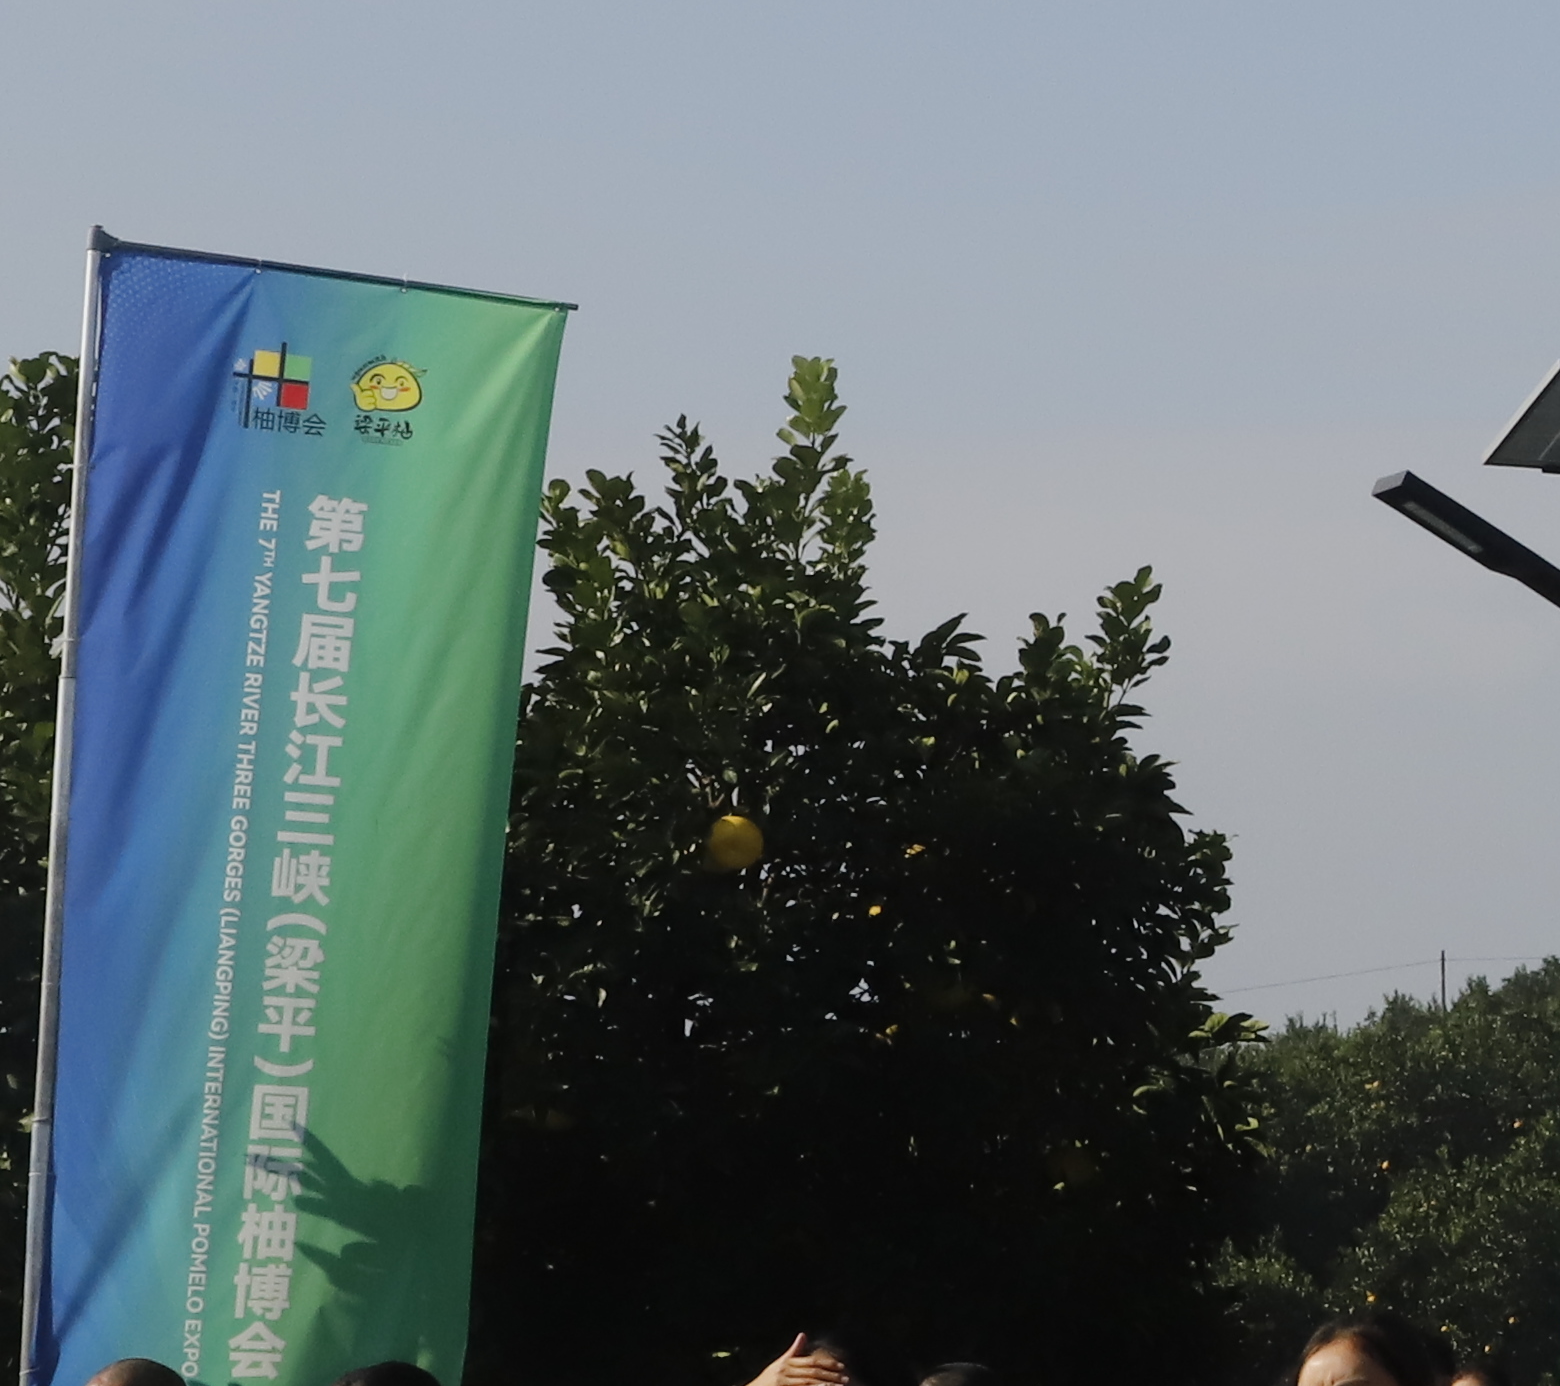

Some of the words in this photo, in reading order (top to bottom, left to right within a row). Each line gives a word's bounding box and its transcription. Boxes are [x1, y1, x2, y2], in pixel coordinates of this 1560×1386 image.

[252, 406, 328, 438] 柚博会
[258, 489, 281, 531] THE
[257, 537, 276, 568] 7TH
[245, 570, 274, 667] YANGTZE
[239, 671, 266, 736] RIVER
[233, 739, 258, 810] THREE
[223, 814, 249, 904] GORGES
[210, 907, 241, 1039] (LIANGPING)
[228, 494, 368, 1380] 第七届长江三峡（梁平）国际柚博会
[194, 1044, 227, 1218] INTERNATIONAL
[186, 1222, 212, 1314] POMELO
[180, 1317, 204, 1379] EXPO
